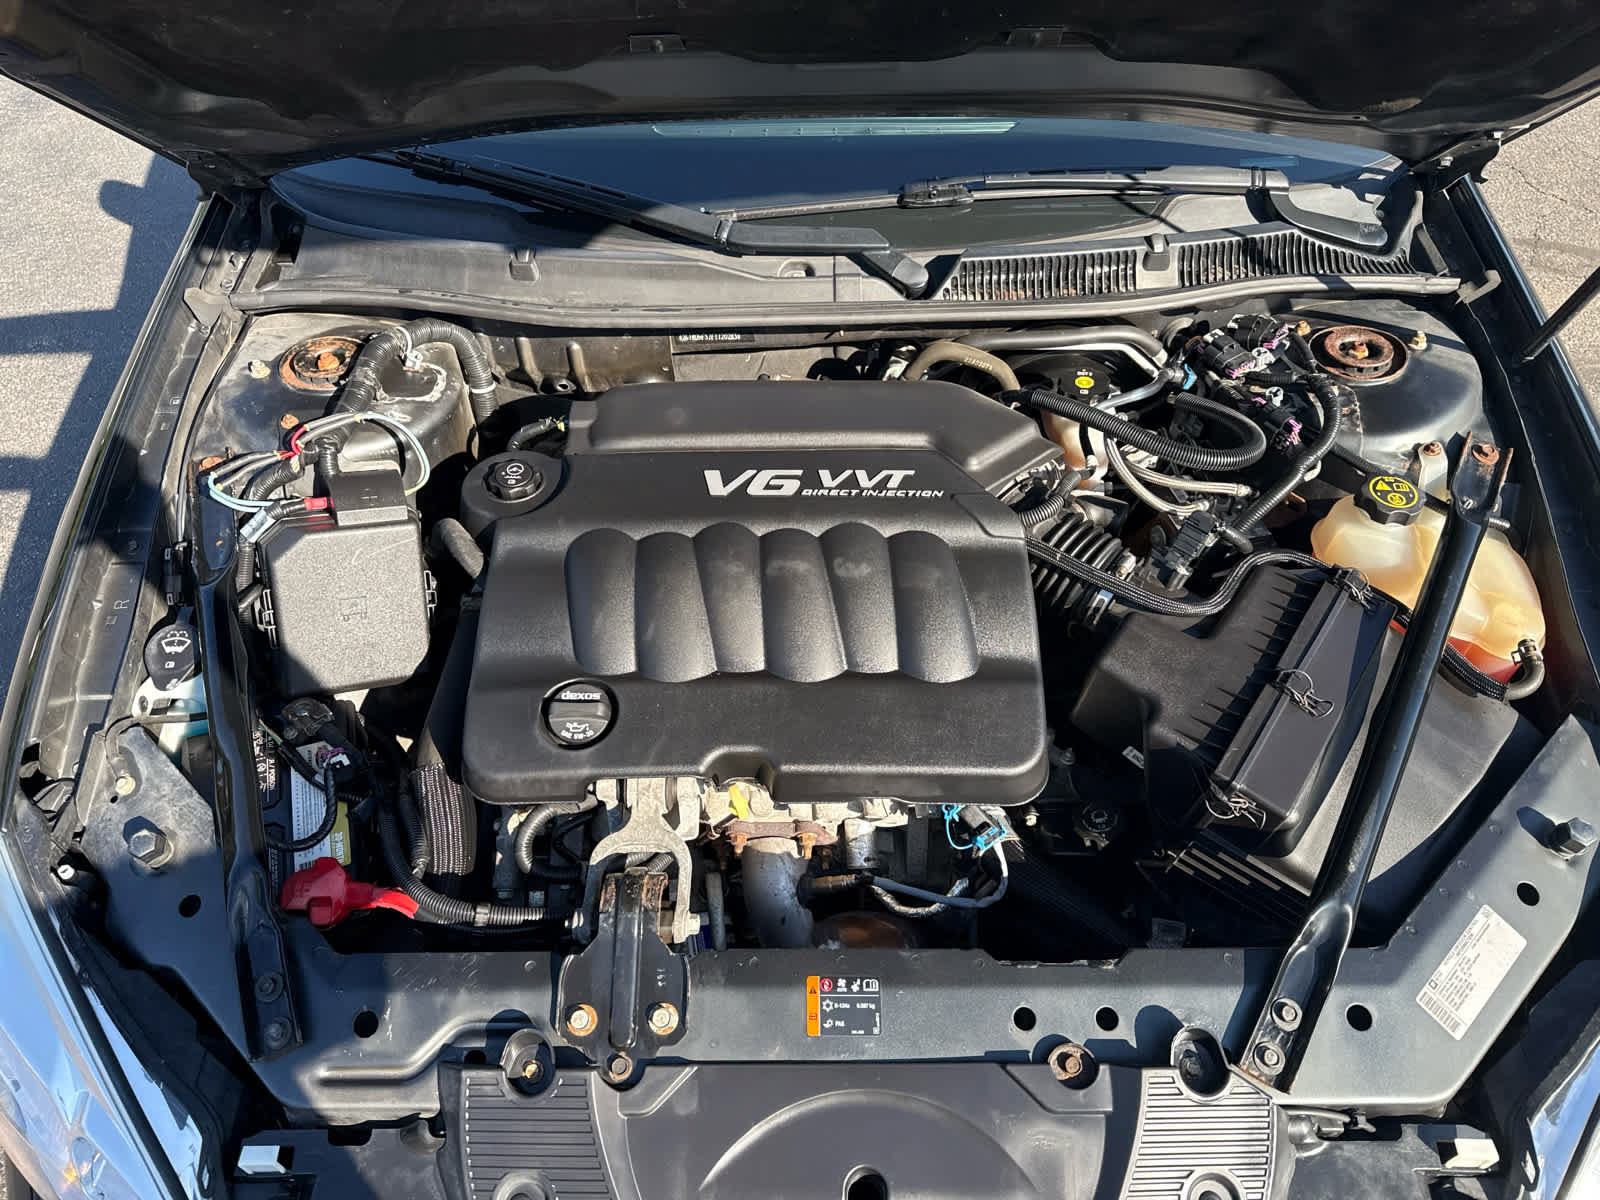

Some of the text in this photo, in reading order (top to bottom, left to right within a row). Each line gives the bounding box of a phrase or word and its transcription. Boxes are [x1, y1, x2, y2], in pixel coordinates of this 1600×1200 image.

[703, 469, 916, 497] V6 VVT
[801, 489, 944, 498] DIRECT INJECTION
[561, 691, 602, 700] dexos
